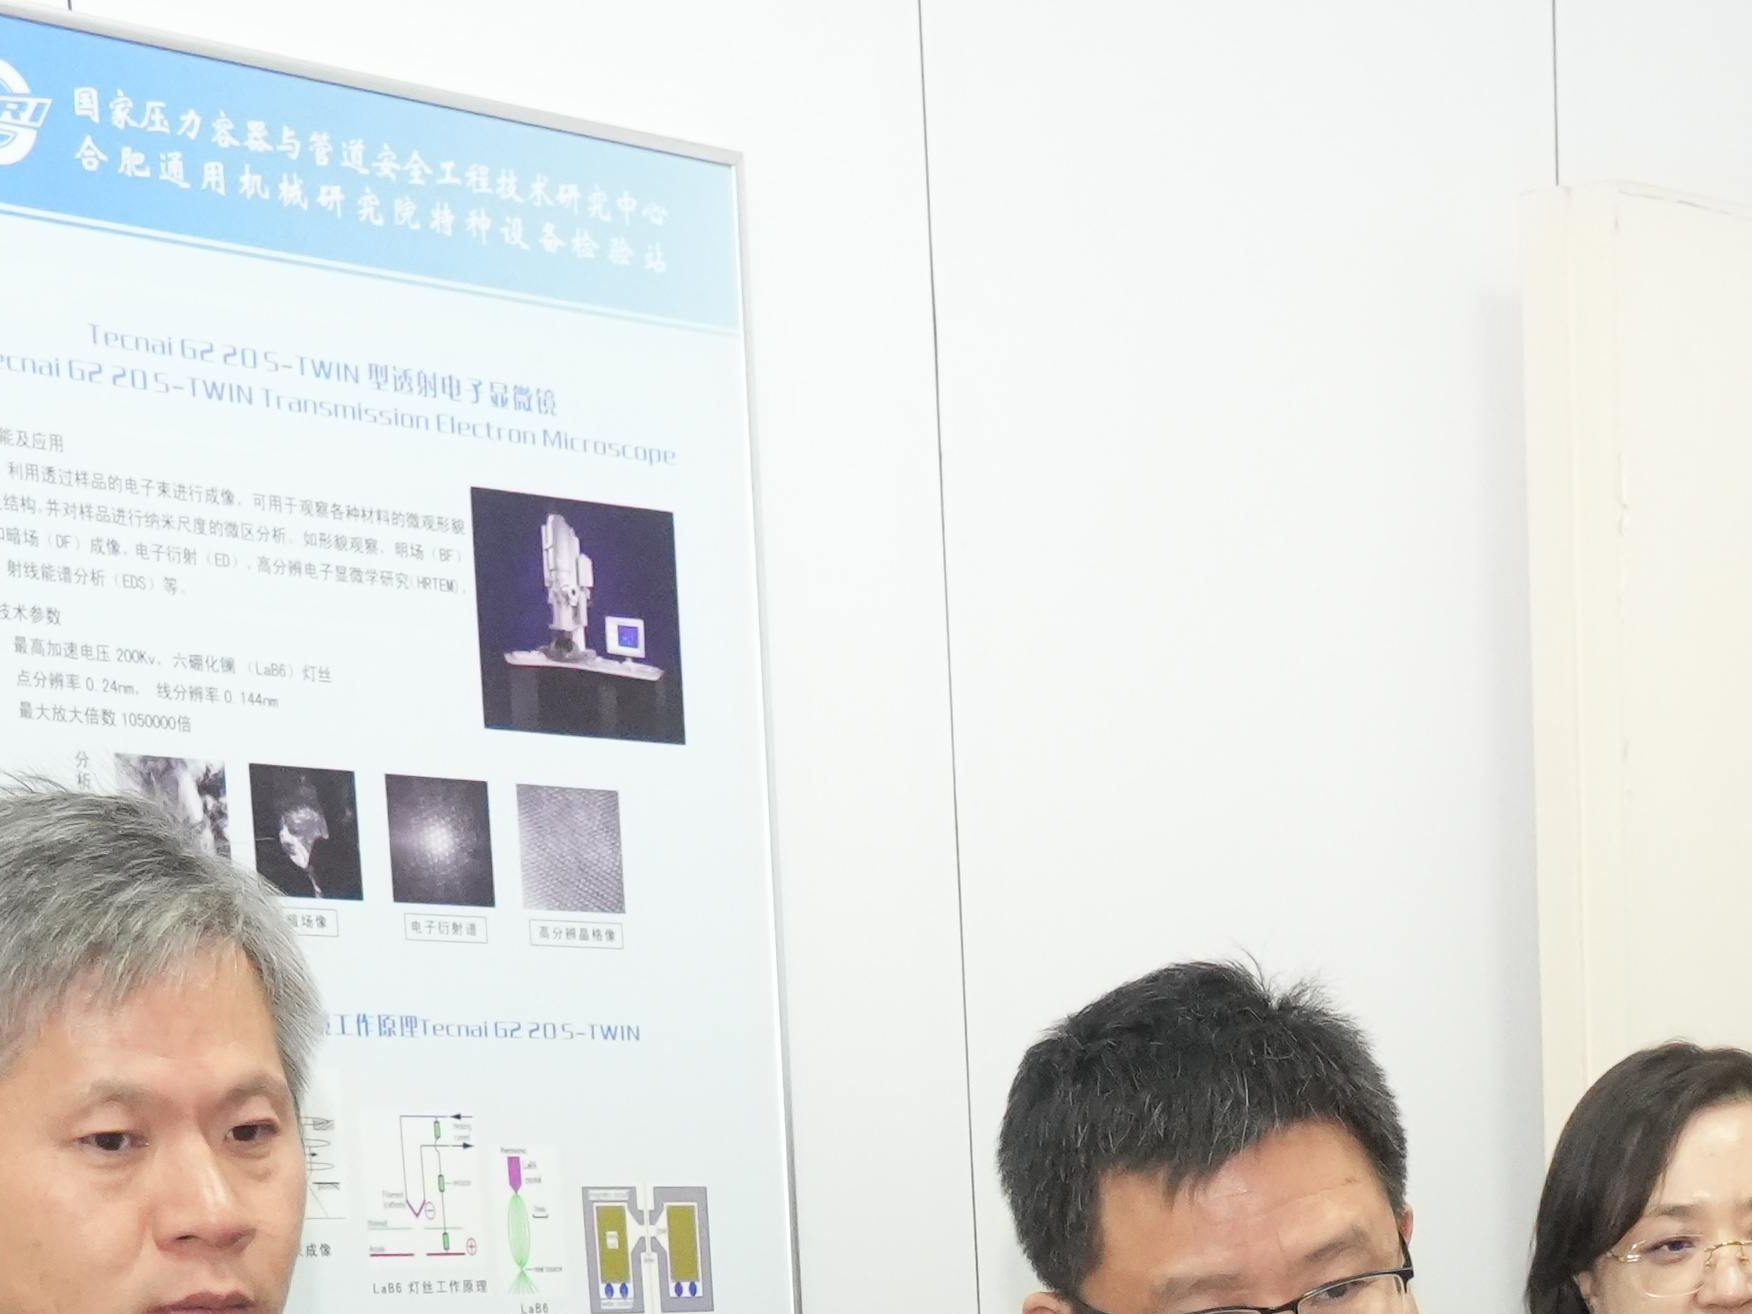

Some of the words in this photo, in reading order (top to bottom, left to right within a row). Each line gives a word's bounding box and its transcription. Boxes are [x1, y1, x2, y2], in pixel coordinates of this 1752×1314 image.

[73, 86, 669, 226] 国家压力容器与管道安全工程技术研究中心
[74, 135, 667, 273] 合肥通用机械研究院特种设备检验站
[89, 323, 173, 356] Tecnai
[367, 362, 558, 416] 型透射电子显微镜
[262, 388, 429, 431] Transmission
[435, 413, 536, 446] Electron
[542, 428, 678, 466] Microscope
